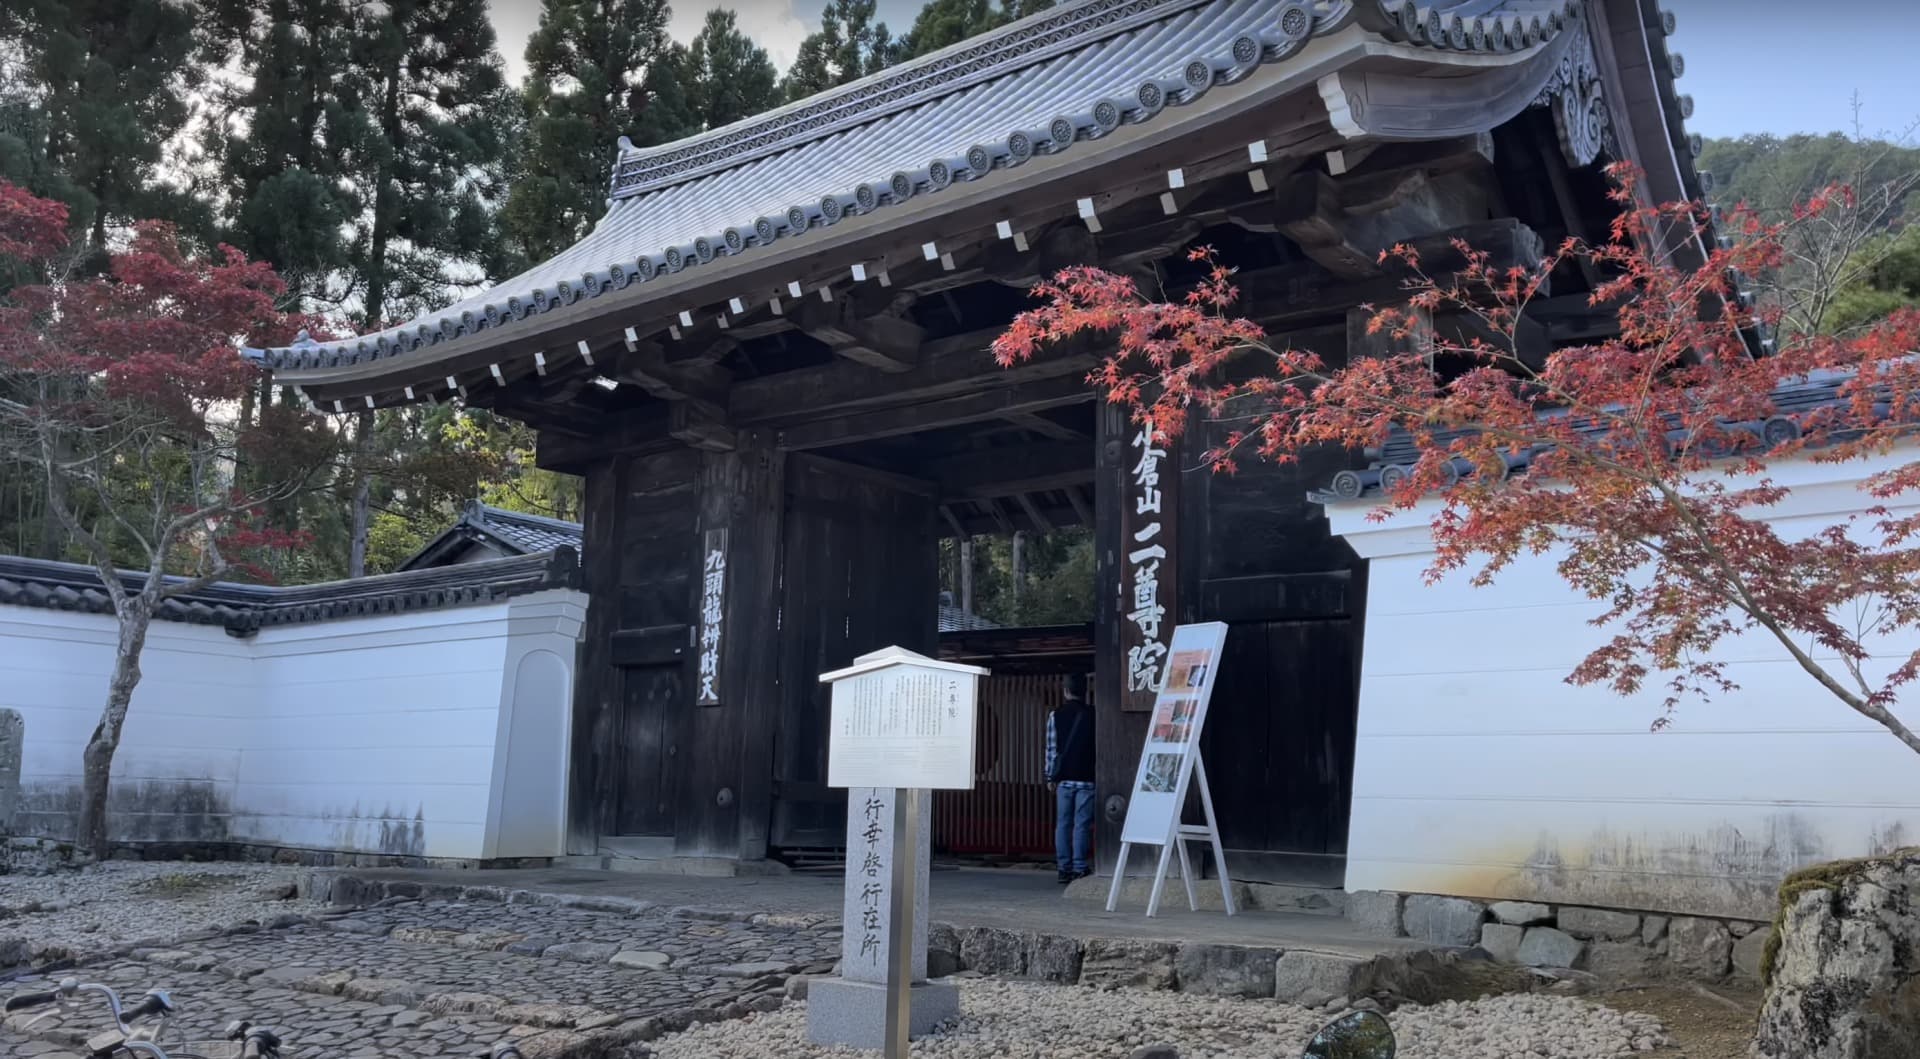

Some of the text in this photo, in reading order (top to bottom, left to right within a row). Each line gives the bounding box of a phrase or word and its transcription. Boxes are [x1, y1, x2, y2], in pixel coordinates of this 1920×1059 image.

[860, 787, 885, 967] 行幸啓行在所
